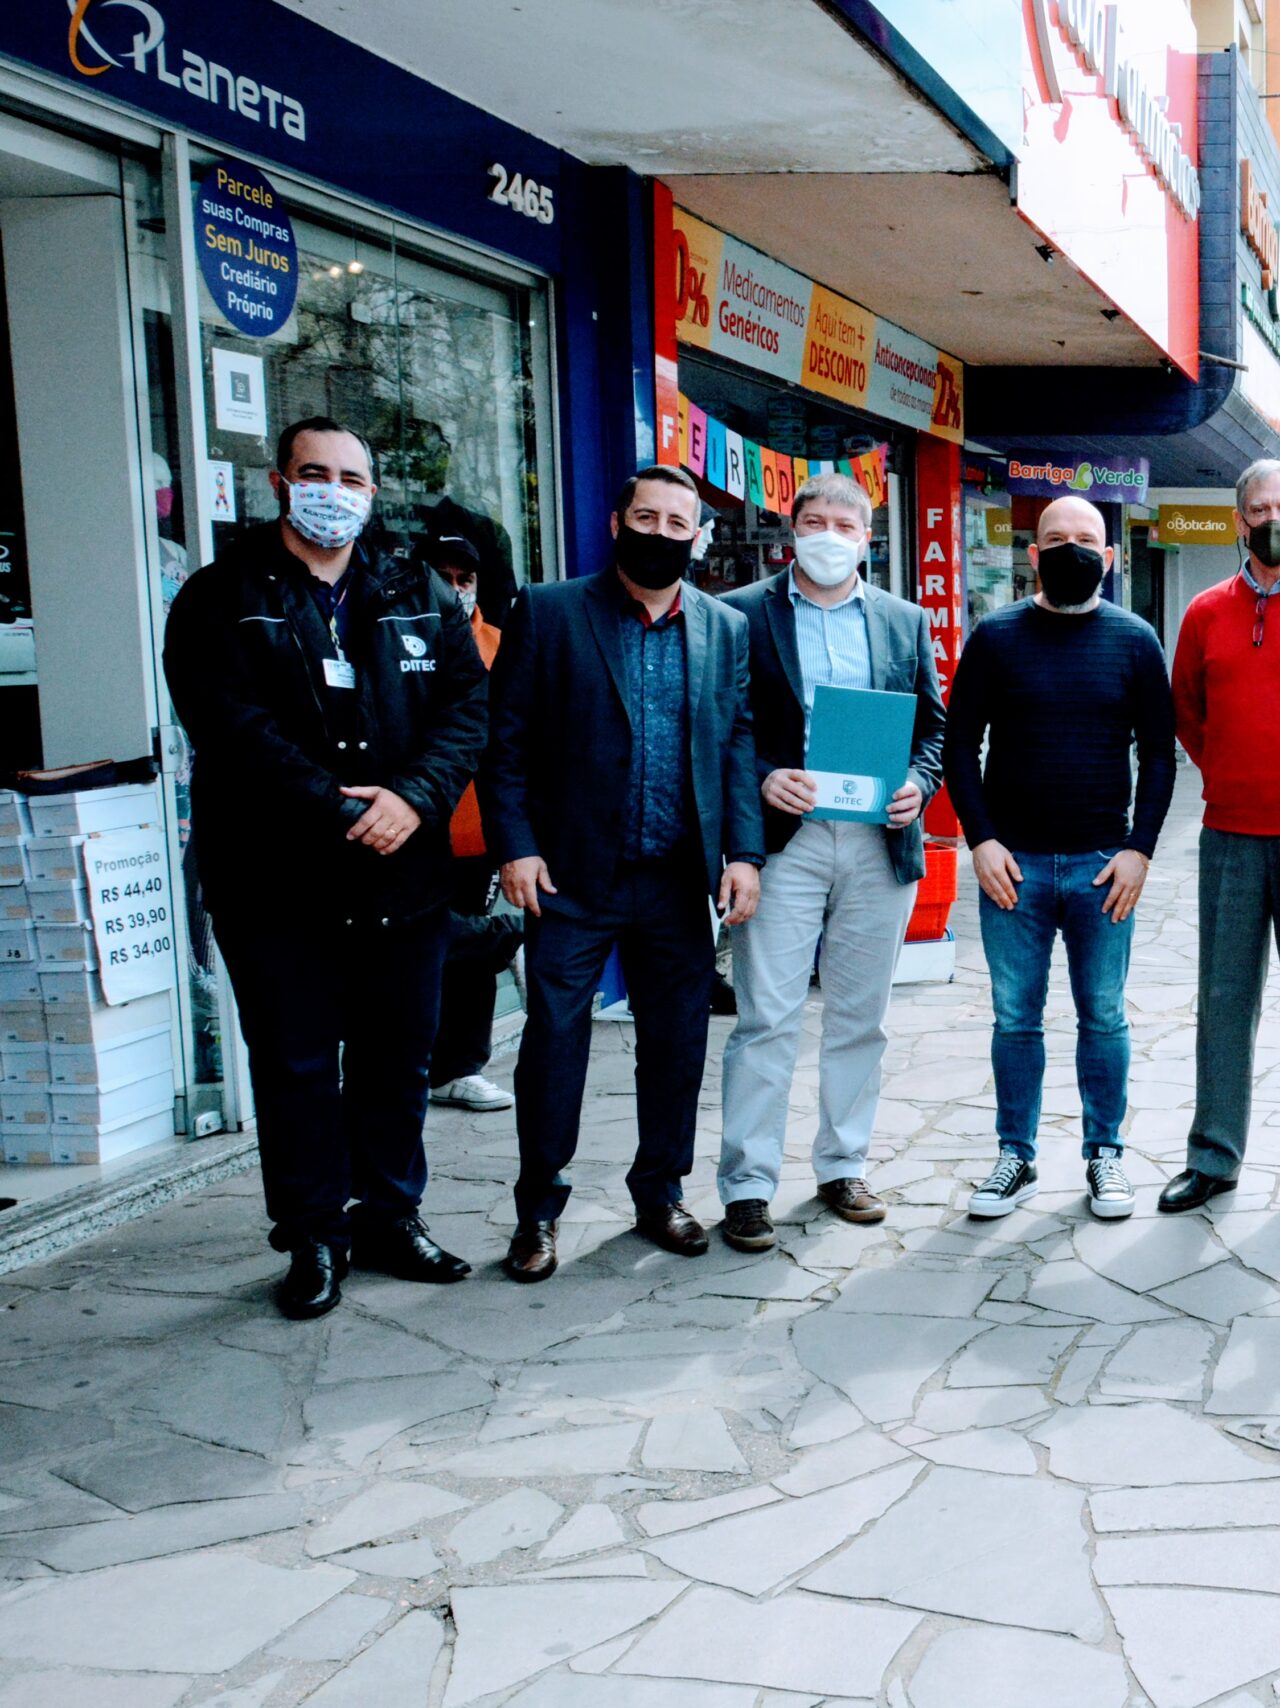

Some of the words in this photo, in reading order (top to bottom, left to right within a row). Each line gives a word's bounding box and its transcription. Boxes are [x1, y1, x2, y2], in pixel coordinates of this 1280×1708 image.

[217, 168, 273, 209] Parcele
[487, 162, 554, 225] 2465
[203, 199, 233, 223] suas
[235, 207, 289, 243] Compras
[205, 224, 242, 258] Sem
[245, 239, 289, 273] Juros
[221, 262, 278, 296] Crediário
[723, 259, 805, 328] Medicamentos
[228, 291, 274, 321] Próprio
[718, 300, 780, 354] Genéricos
[814, 303, 837, 343] Aqui
[838, 317, 856, 349] tem
[809, 340, 866, 393] DESCONTO
[874, 338, 938, 390] Anticoncepcionais
[1009, 460, 1074, 484] Barriga
[1093, 466, 1146, 486] Verde
[400, 660, 436, 672] DITEC
[834, 795, 863, 806] DITEC
[95, 850, 160, 874] Promoção
[124, 876, 162, 899] 44,40
[127, 906, 167, 928] 39,90
[132, 936, 171, 958] 34,00
